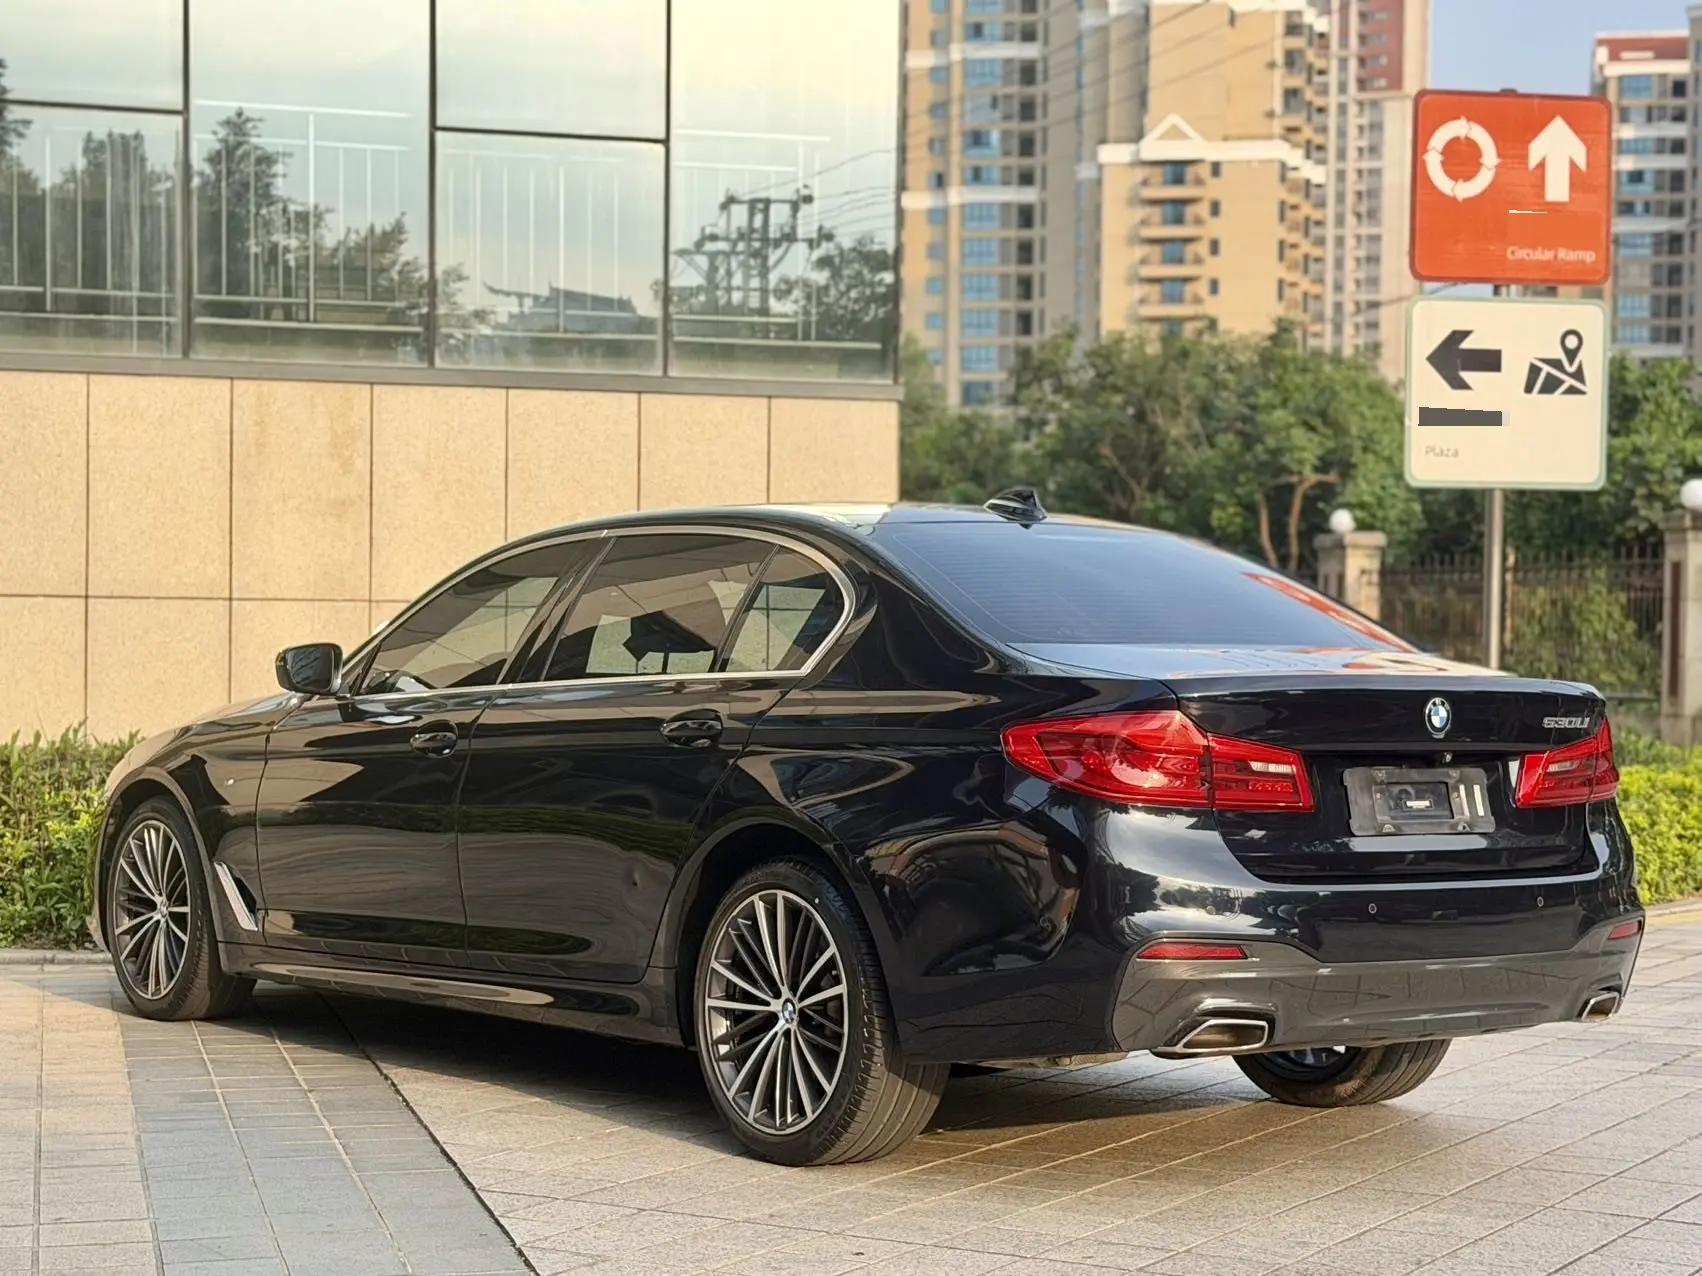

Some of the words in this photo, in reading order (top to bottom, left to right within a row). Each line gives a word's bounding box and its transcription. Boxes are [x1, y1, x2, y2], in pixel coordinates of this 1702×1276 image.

[1507, 246, 1555, 261] Circular
[1557, 247, 1596, 264] Ramp
[1425, 445, 1459, 458] Plaza
